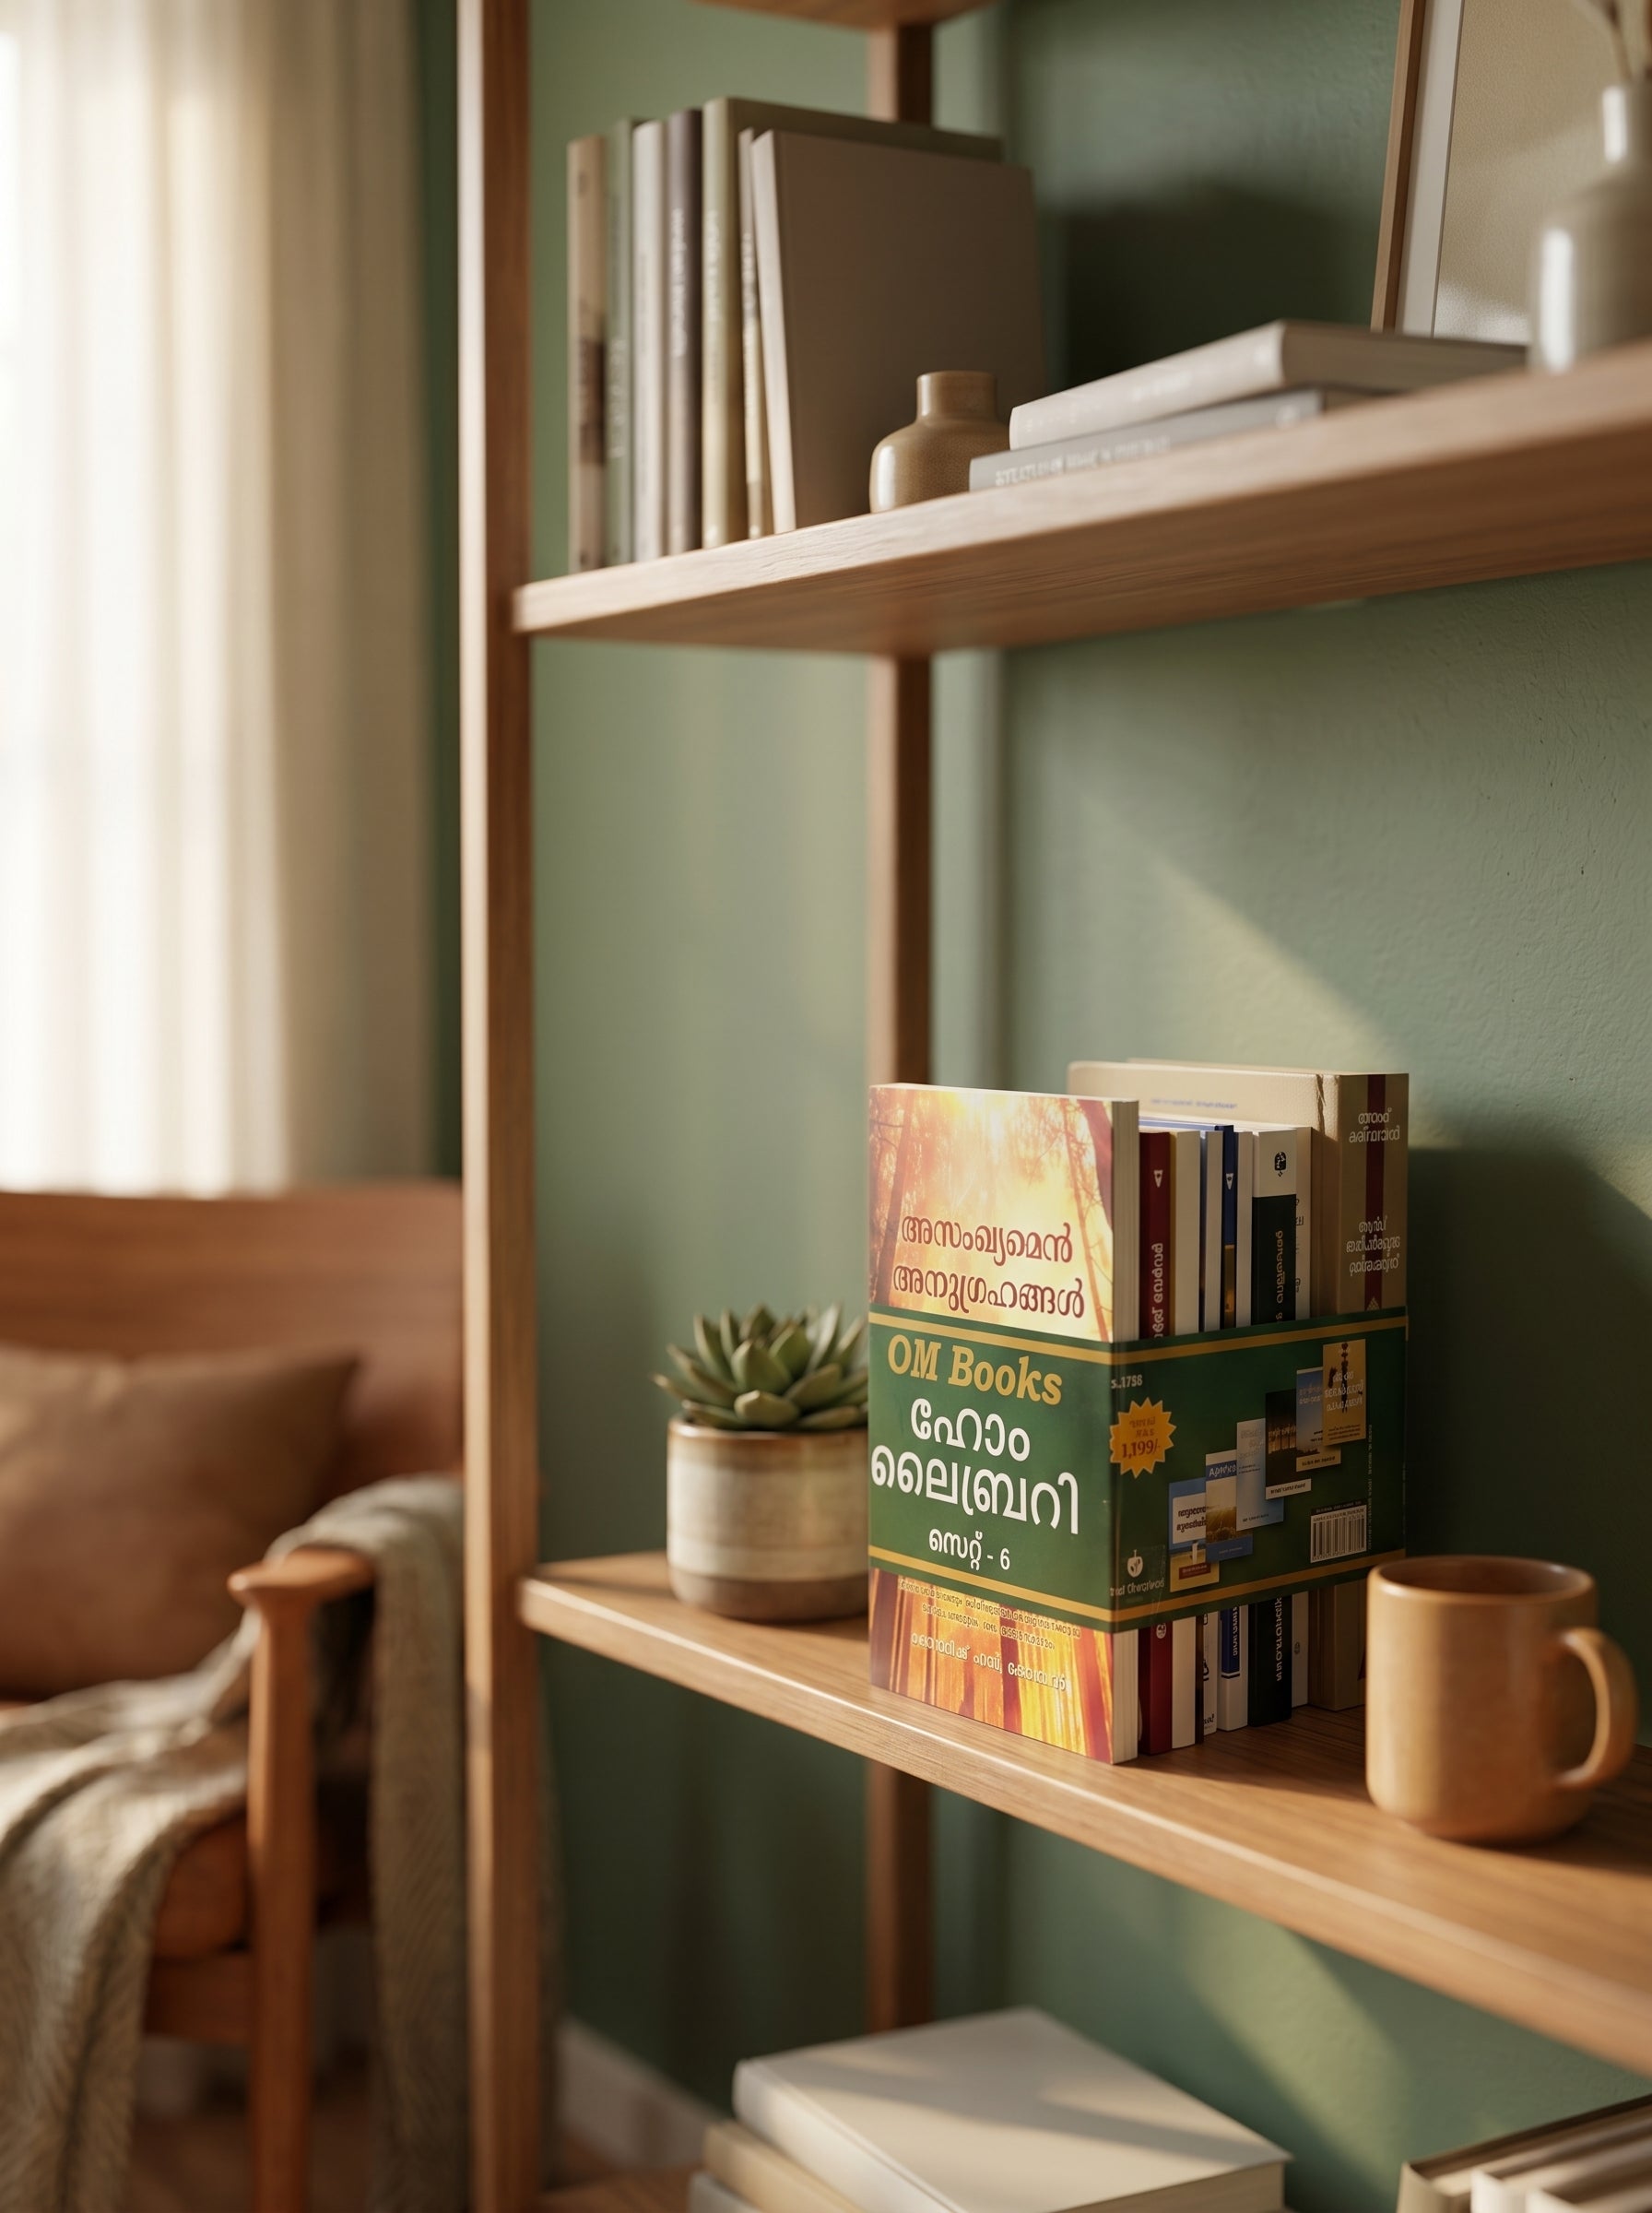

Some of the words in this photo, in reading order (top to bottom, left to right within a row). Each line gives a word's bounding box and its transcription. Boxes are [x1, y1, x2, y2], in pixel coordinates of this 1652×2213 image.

[893, 1265, 1085, 1319] അനുഗ്രഹങ്ങൾ
[888, 1334, 941, 1381] OM
[948, 1344, 1063, 1405] Books
[911, 1398, 1031, 1462] ഹോം
[871, 1445, 1079, 1535] ലൈബ്രറി
[928, 1528, 984, 1571] സെറ്റ്
[999, 1547, 1010, 1570] 6
